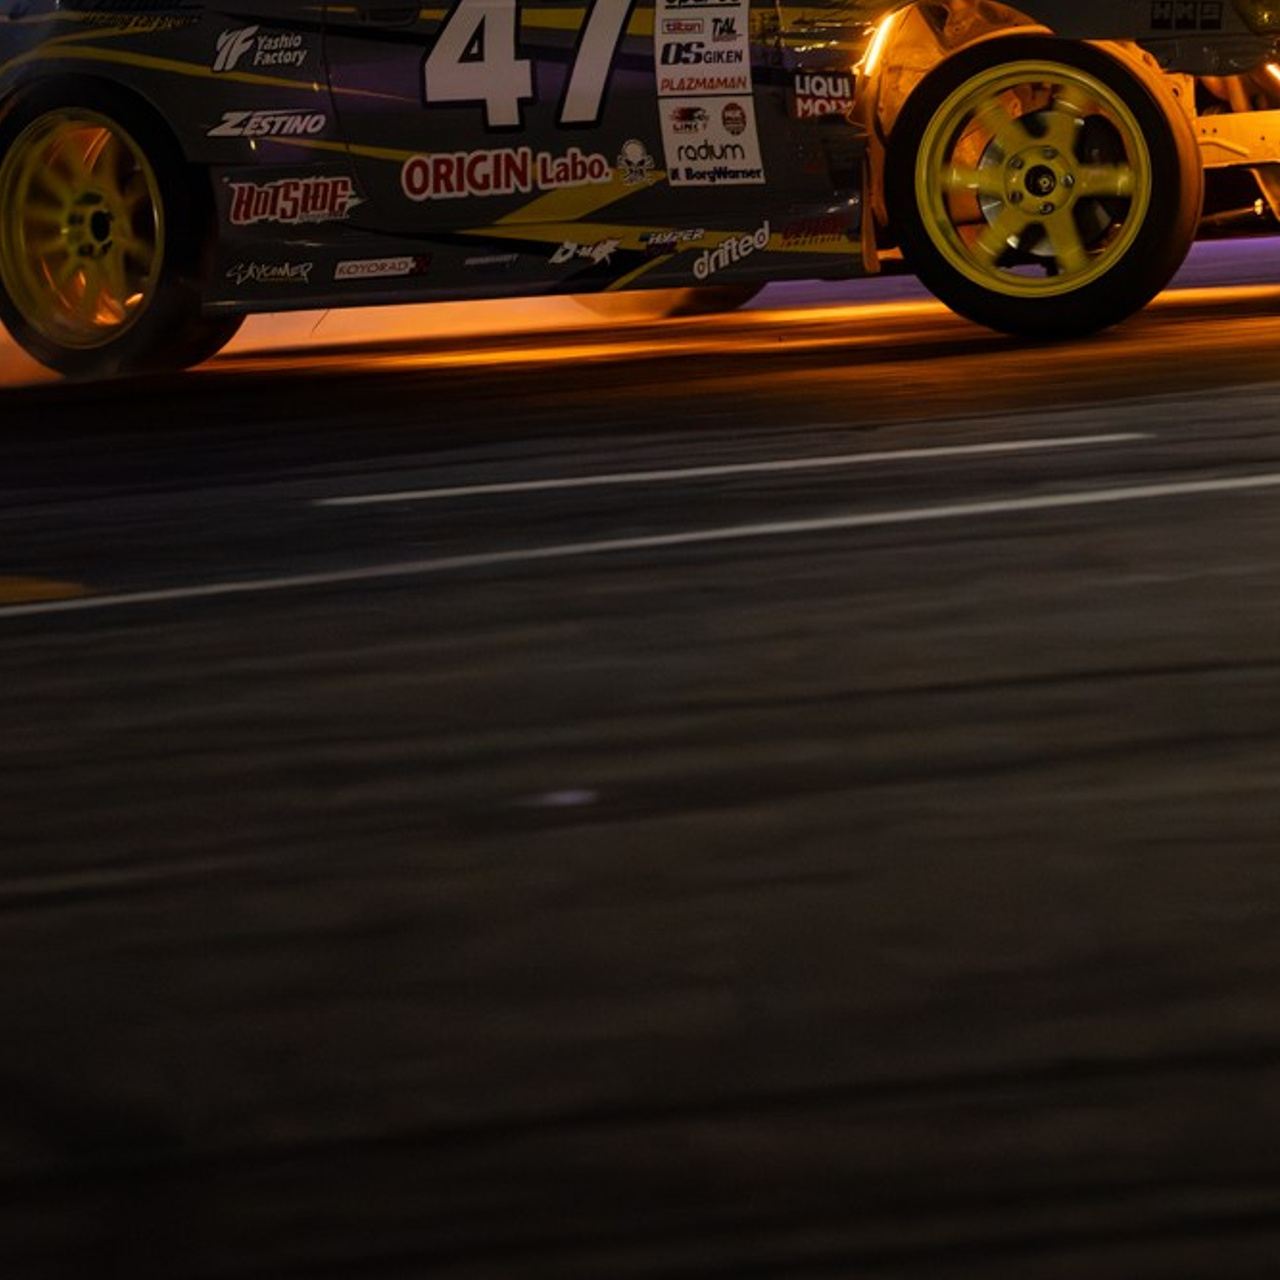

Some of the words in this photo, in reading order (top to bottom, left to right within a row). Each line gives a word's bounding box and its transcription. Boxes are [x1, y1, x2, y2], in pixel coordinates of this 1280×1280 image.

[256, 33, 303, 51] Yashio
[660, 41, 705, 65] OS
[704, 49, 743, 64] GIKEN
[252, 49, 307, 68] Factory
[660, 76, 747, 91] PLAZMAMAN
[794, 73, 852, 99] LIQUI
[795, 96, 856, 119] MOLY
[205, 109, 327, 138] ZESTINO
[677, 140, 745, 162] radium
[403, 150, 529, 197] ORIGIN
[539, 152, 610, 186] Labo.
[684, 166, 763, 183] BorgWarner
[692, 220, 771, 280] drifted
[337, 260, 410, 276] KOYORAD
